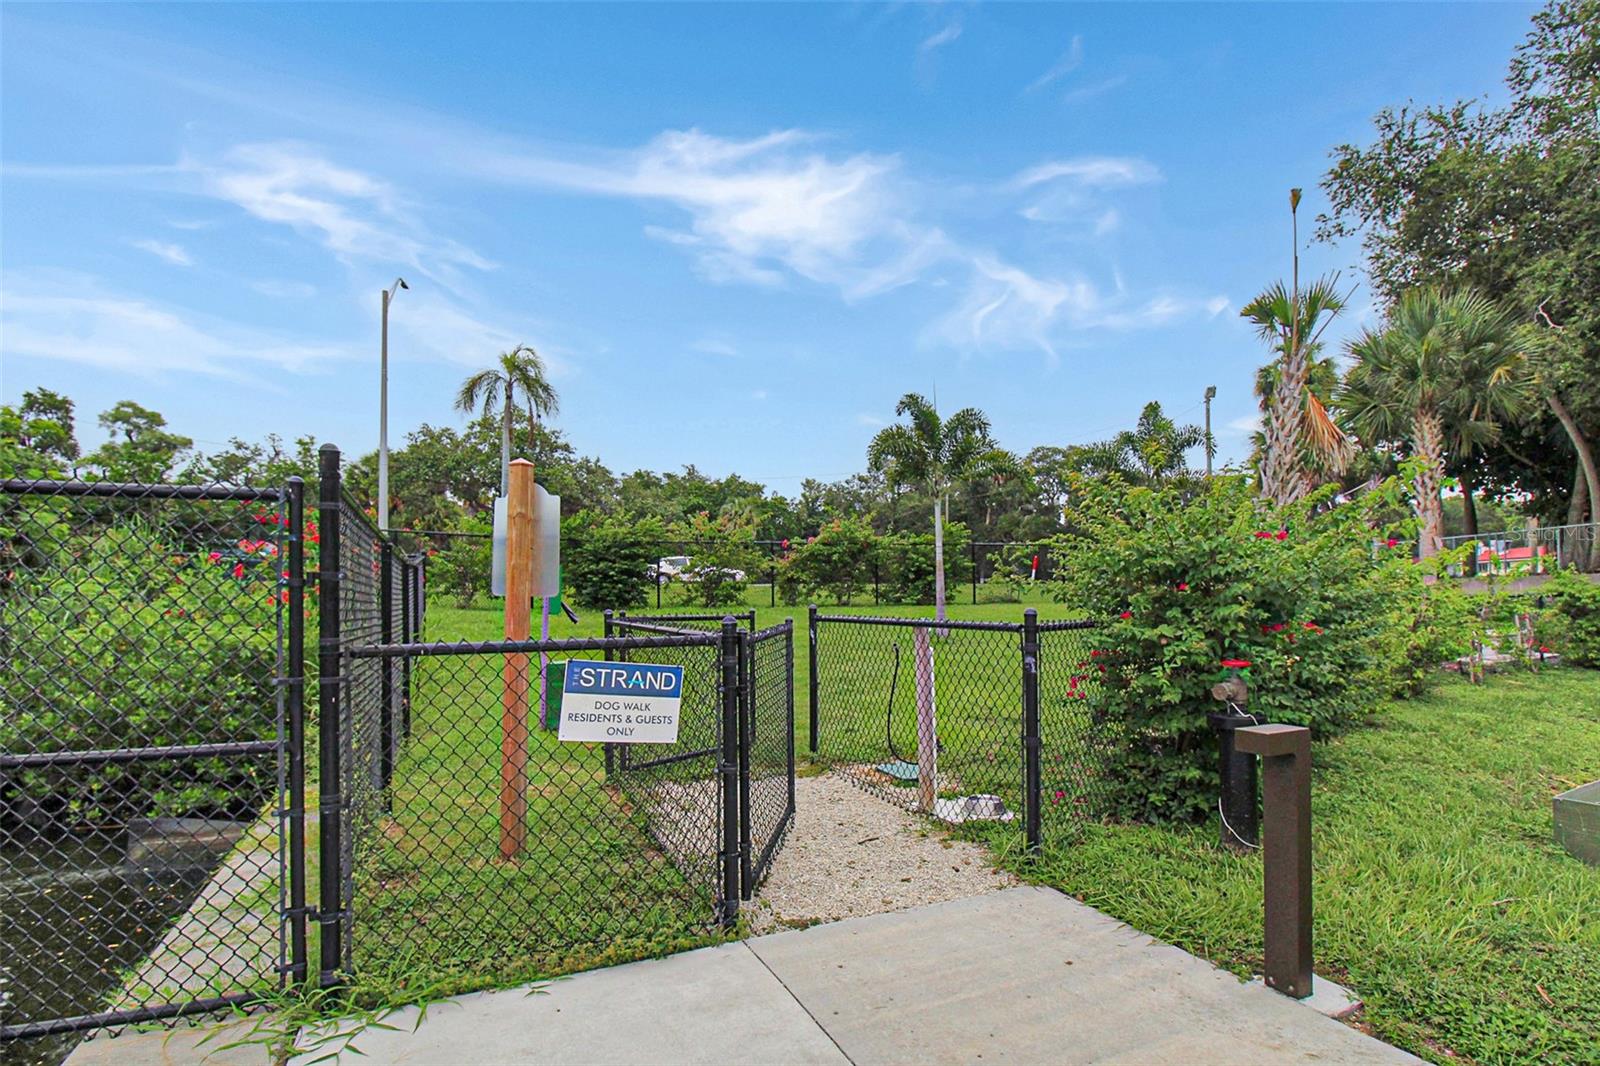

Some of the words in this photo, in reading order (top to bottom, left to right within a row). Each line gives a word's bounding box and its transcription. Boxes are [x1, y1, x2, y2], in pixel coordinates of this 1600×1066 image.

[572, 667, 580, 686] THE
[580, 667, 676, 690] STRAND
[594, 701, 620, 711] DOG
[624, 702, 651, 712] WALK
[567, 712, 622, 723] RESIDENTS
[625, 715, 632, 724] &
[635, 714, 673, 725] GUESTS
[606, 726, 635, 736] ONLY
